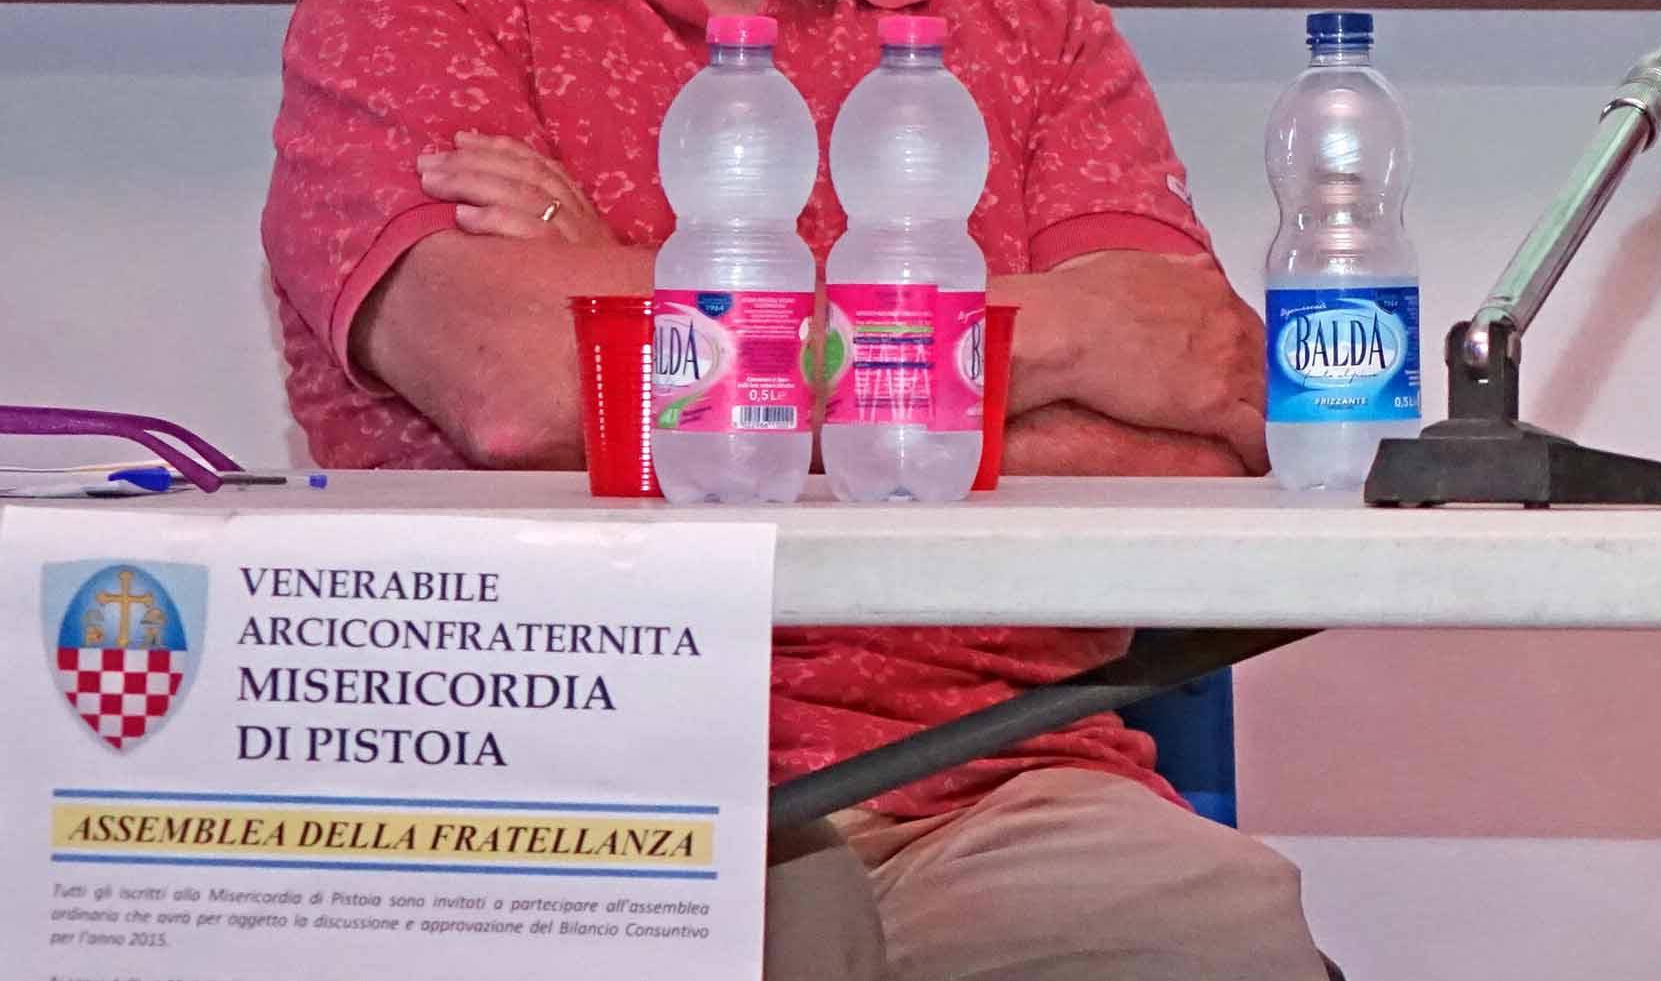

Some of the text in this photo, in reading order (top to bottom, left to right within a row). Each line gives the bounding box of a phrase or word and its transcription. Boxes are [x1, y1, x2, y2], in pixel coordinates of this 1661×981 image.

[654, 318, 700, 381] LDA
[1294, 312, 1387, 372] BALDA
[239, 566, 501, 603] VENERABILE
[237, 616, 700, 657] ARCICONFRATERNITA
[237, 666, 617, 711] MISERICORDIA
[237, 725, 508, 768] DI PISTOIA
[68, 814, 696, 858] ASSEMBLEA DELLA FRATELLANZA
